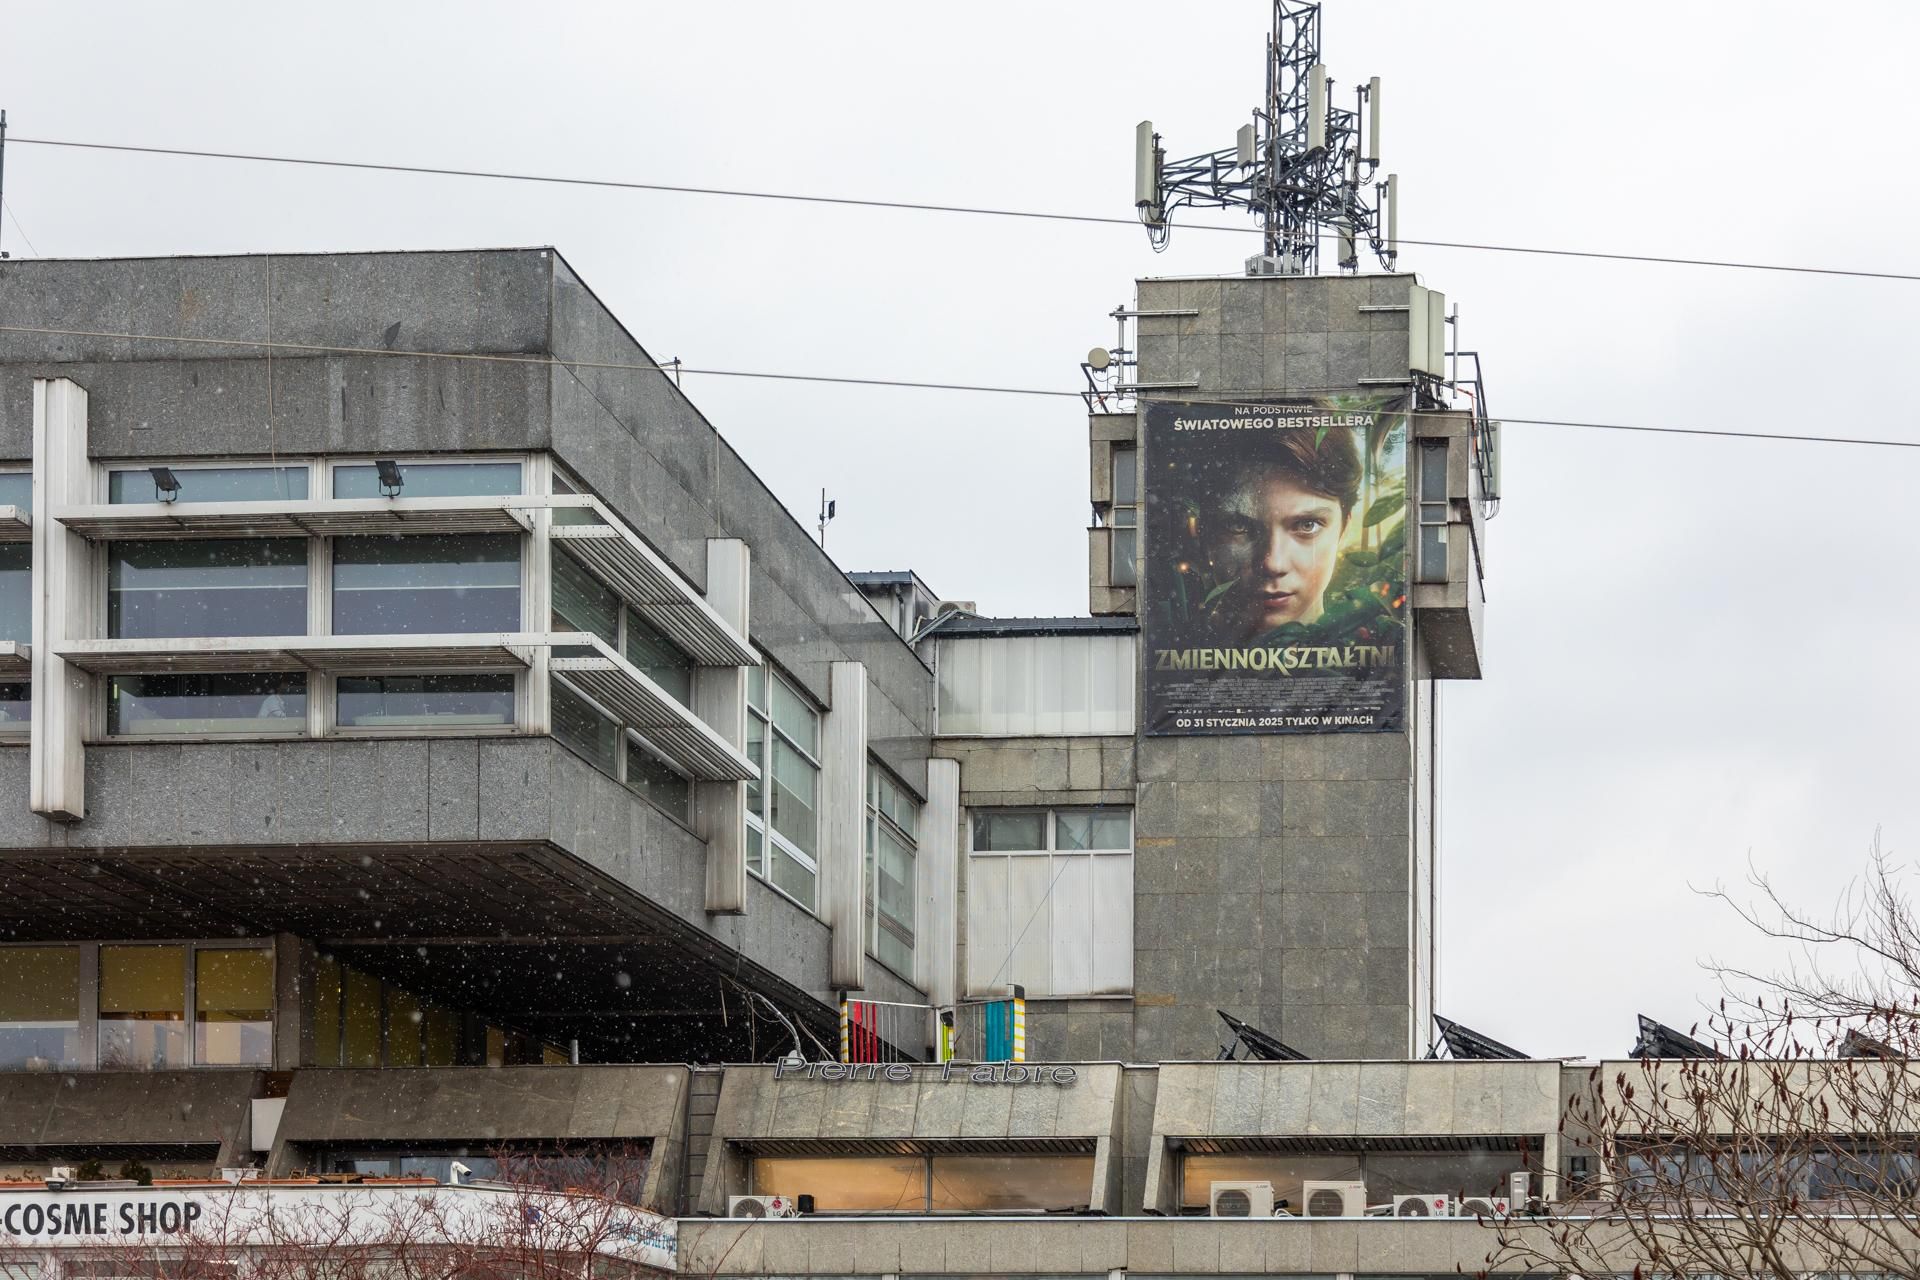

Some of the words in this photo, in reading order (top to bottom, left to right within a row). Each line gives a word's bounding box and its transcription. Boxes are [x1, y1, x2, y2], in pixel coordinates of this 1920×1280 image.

[1235, 406, 1250, 415] NA
[1253, 405, 1313, 415] PODSTAWIE
[1174, 417, 1274, 431] ŚWIATOWEGO
[1277, 415, 1374, 429] BESTSELLERA
[1155, 646, 1396, 676] ZMIENNOKSZTAŁTNI
[1176, 719, 1192, 727] OD
[1194, 718, 1204, 727] 31
[1206, 718, 1257, 727] STYCZNIA
[1259, 717, 1283, 726] 2025
[1286, 716, 1319, 726] TYLKO
[1321, 716, 1333, 725] W
[1335, 715, 1374, 725] KINACH
[774, 1056, 912, 1080] Pierre
[942, 1058, 1078, 1083] Fabre
[0, 1202, 108, 1236] COSME
[119, 1202, 202, 1235] SHOP
